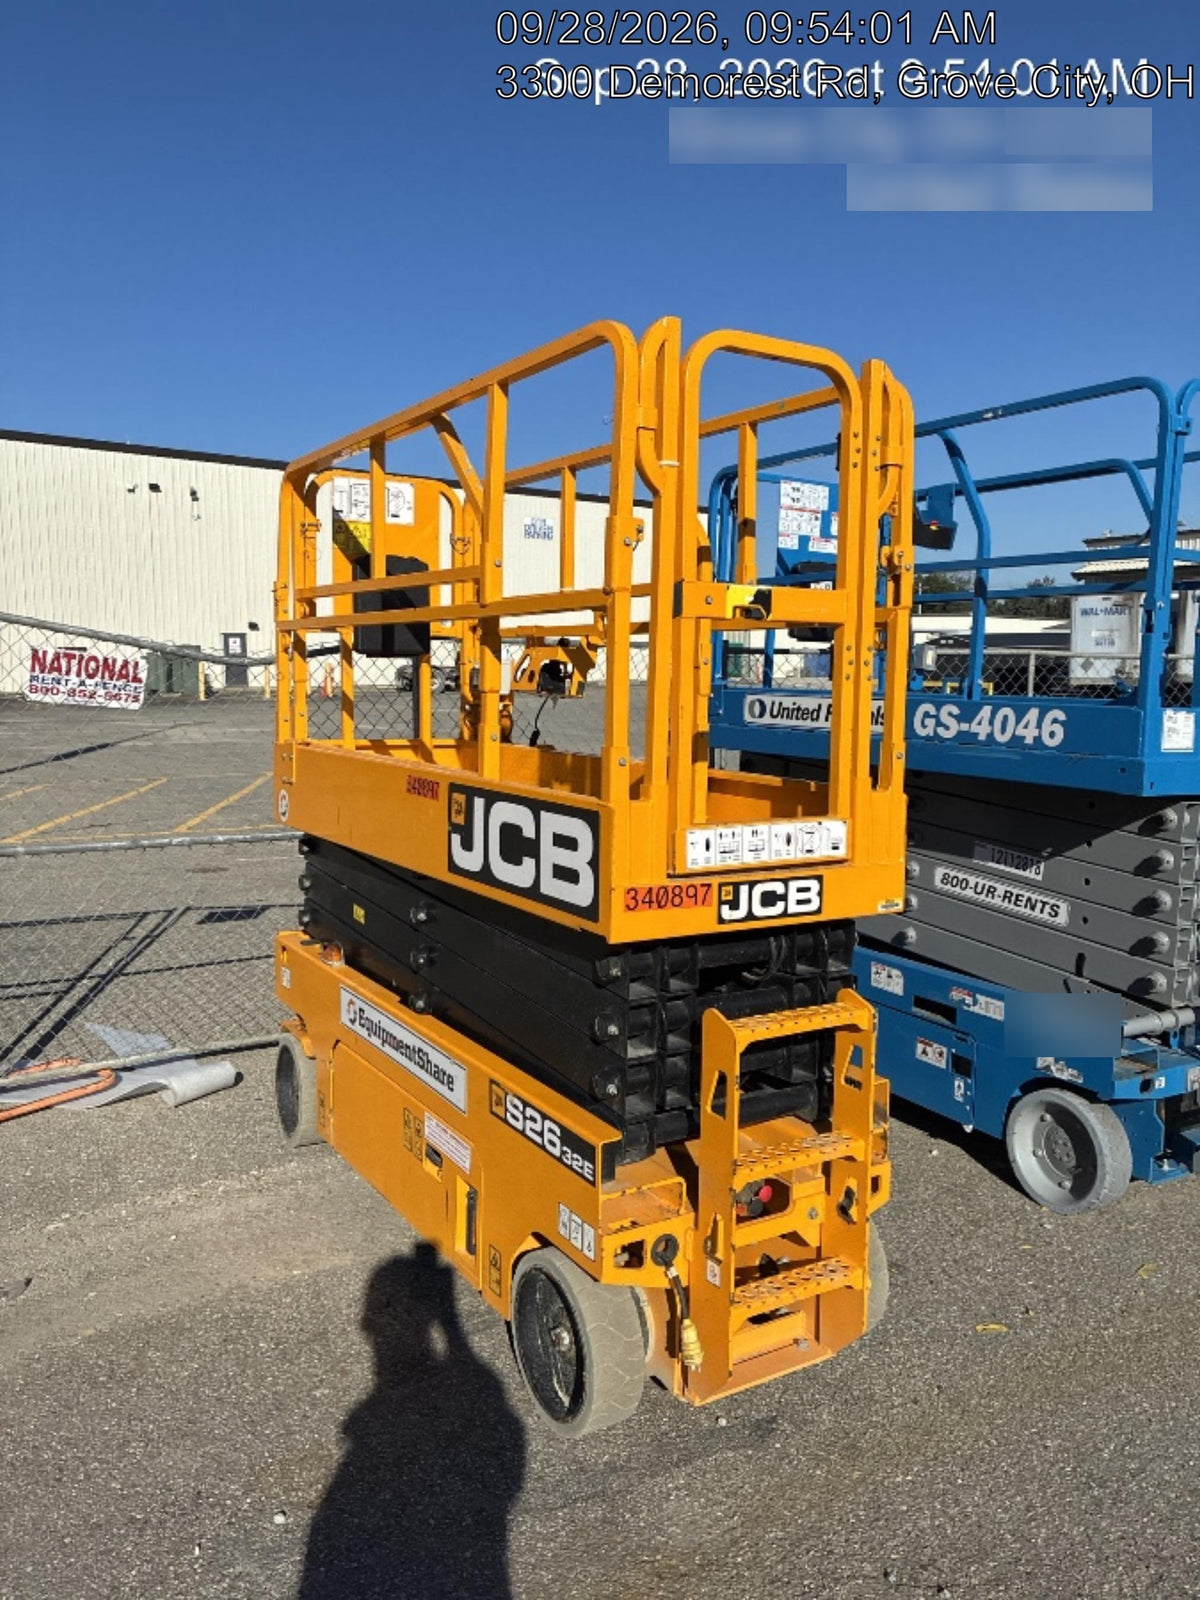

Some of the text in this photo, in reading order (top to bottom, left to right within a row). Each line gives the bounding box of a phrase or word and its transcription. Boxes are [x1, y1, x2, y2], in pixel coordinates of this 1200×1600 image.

[30, 648, 143, 684] NATIONAL
[769, 700, 822, 723] United
[913, 703, 1067, 747] GS-4046
[451, 796, 595, 909] JCB
[625, 883, 712, 911] 340897
[720, 879, 821, 921] JCB
[940, 872, 1060, 918] 800-UR-RENTS
[357, 1007, 455, 1093] EquipmentShare
[505, 1094, 561, 1158] S26
[562, 1146, 595, 1182] 32E
